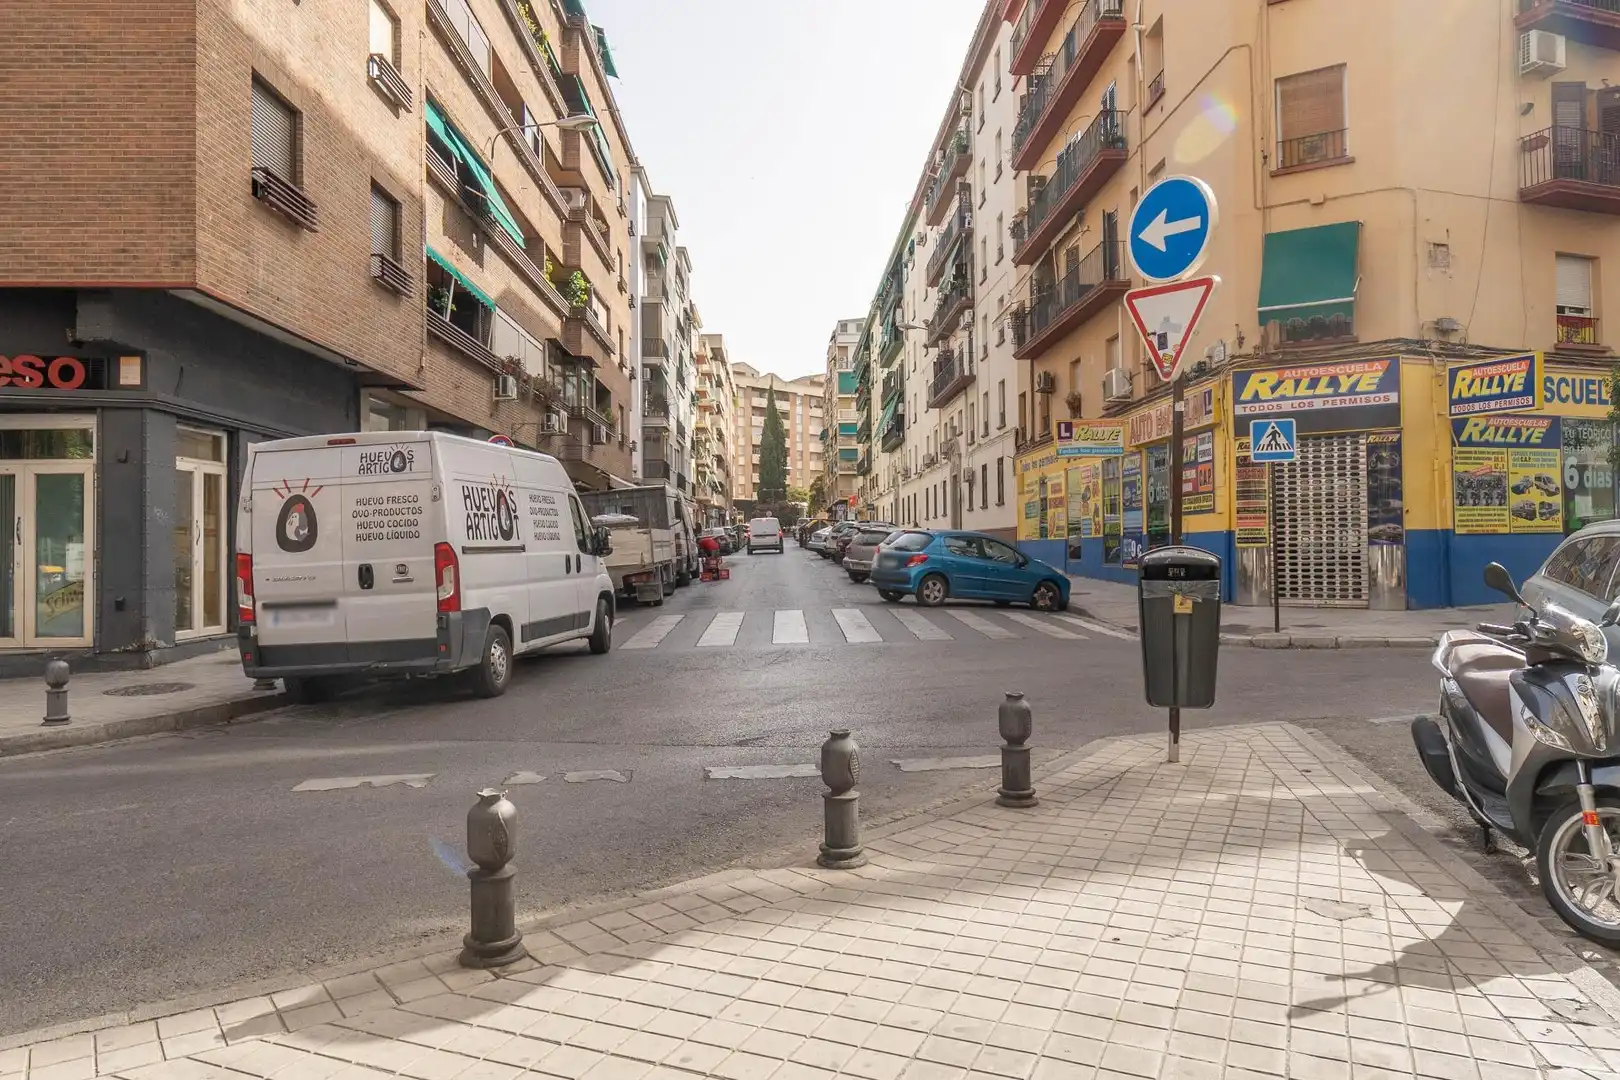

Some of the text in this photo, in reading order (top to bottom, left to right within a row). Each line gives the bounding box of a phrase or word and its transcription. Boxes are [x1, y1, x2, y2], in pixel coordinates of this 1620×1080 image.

[1282, 362, 1382, 378] AUTOESCUELA
[1473, 361, 1526, 377] AUTOESCUELA
[1239, 371, 1383, 401] RALLYE
[1451, 369, 1527, 399] RALLYE
[1241, 394, 1390, 413] TODOS LOS PERMISOS
[1453, 397, 1530, 412] TODOS LOS PERMISOS
[1060, 422, 1070, 437] L
[1129, 411, 1153, 444] AUTO
[1459, 417, 1547, 443] RALLYE
[1488, 418, 1549, 428] AUTOESCUELAS
[1564, 456, 1579, 490] 6
[355, 494, 419, 507] HUEVO FRESCO
[351, 506, 423, 519] OVO-PRODUCTOS
[356, 518, 419, 530] HUEVO COCIDO
[355, 529, 420, 542] HUEVO LÍQUIDO
